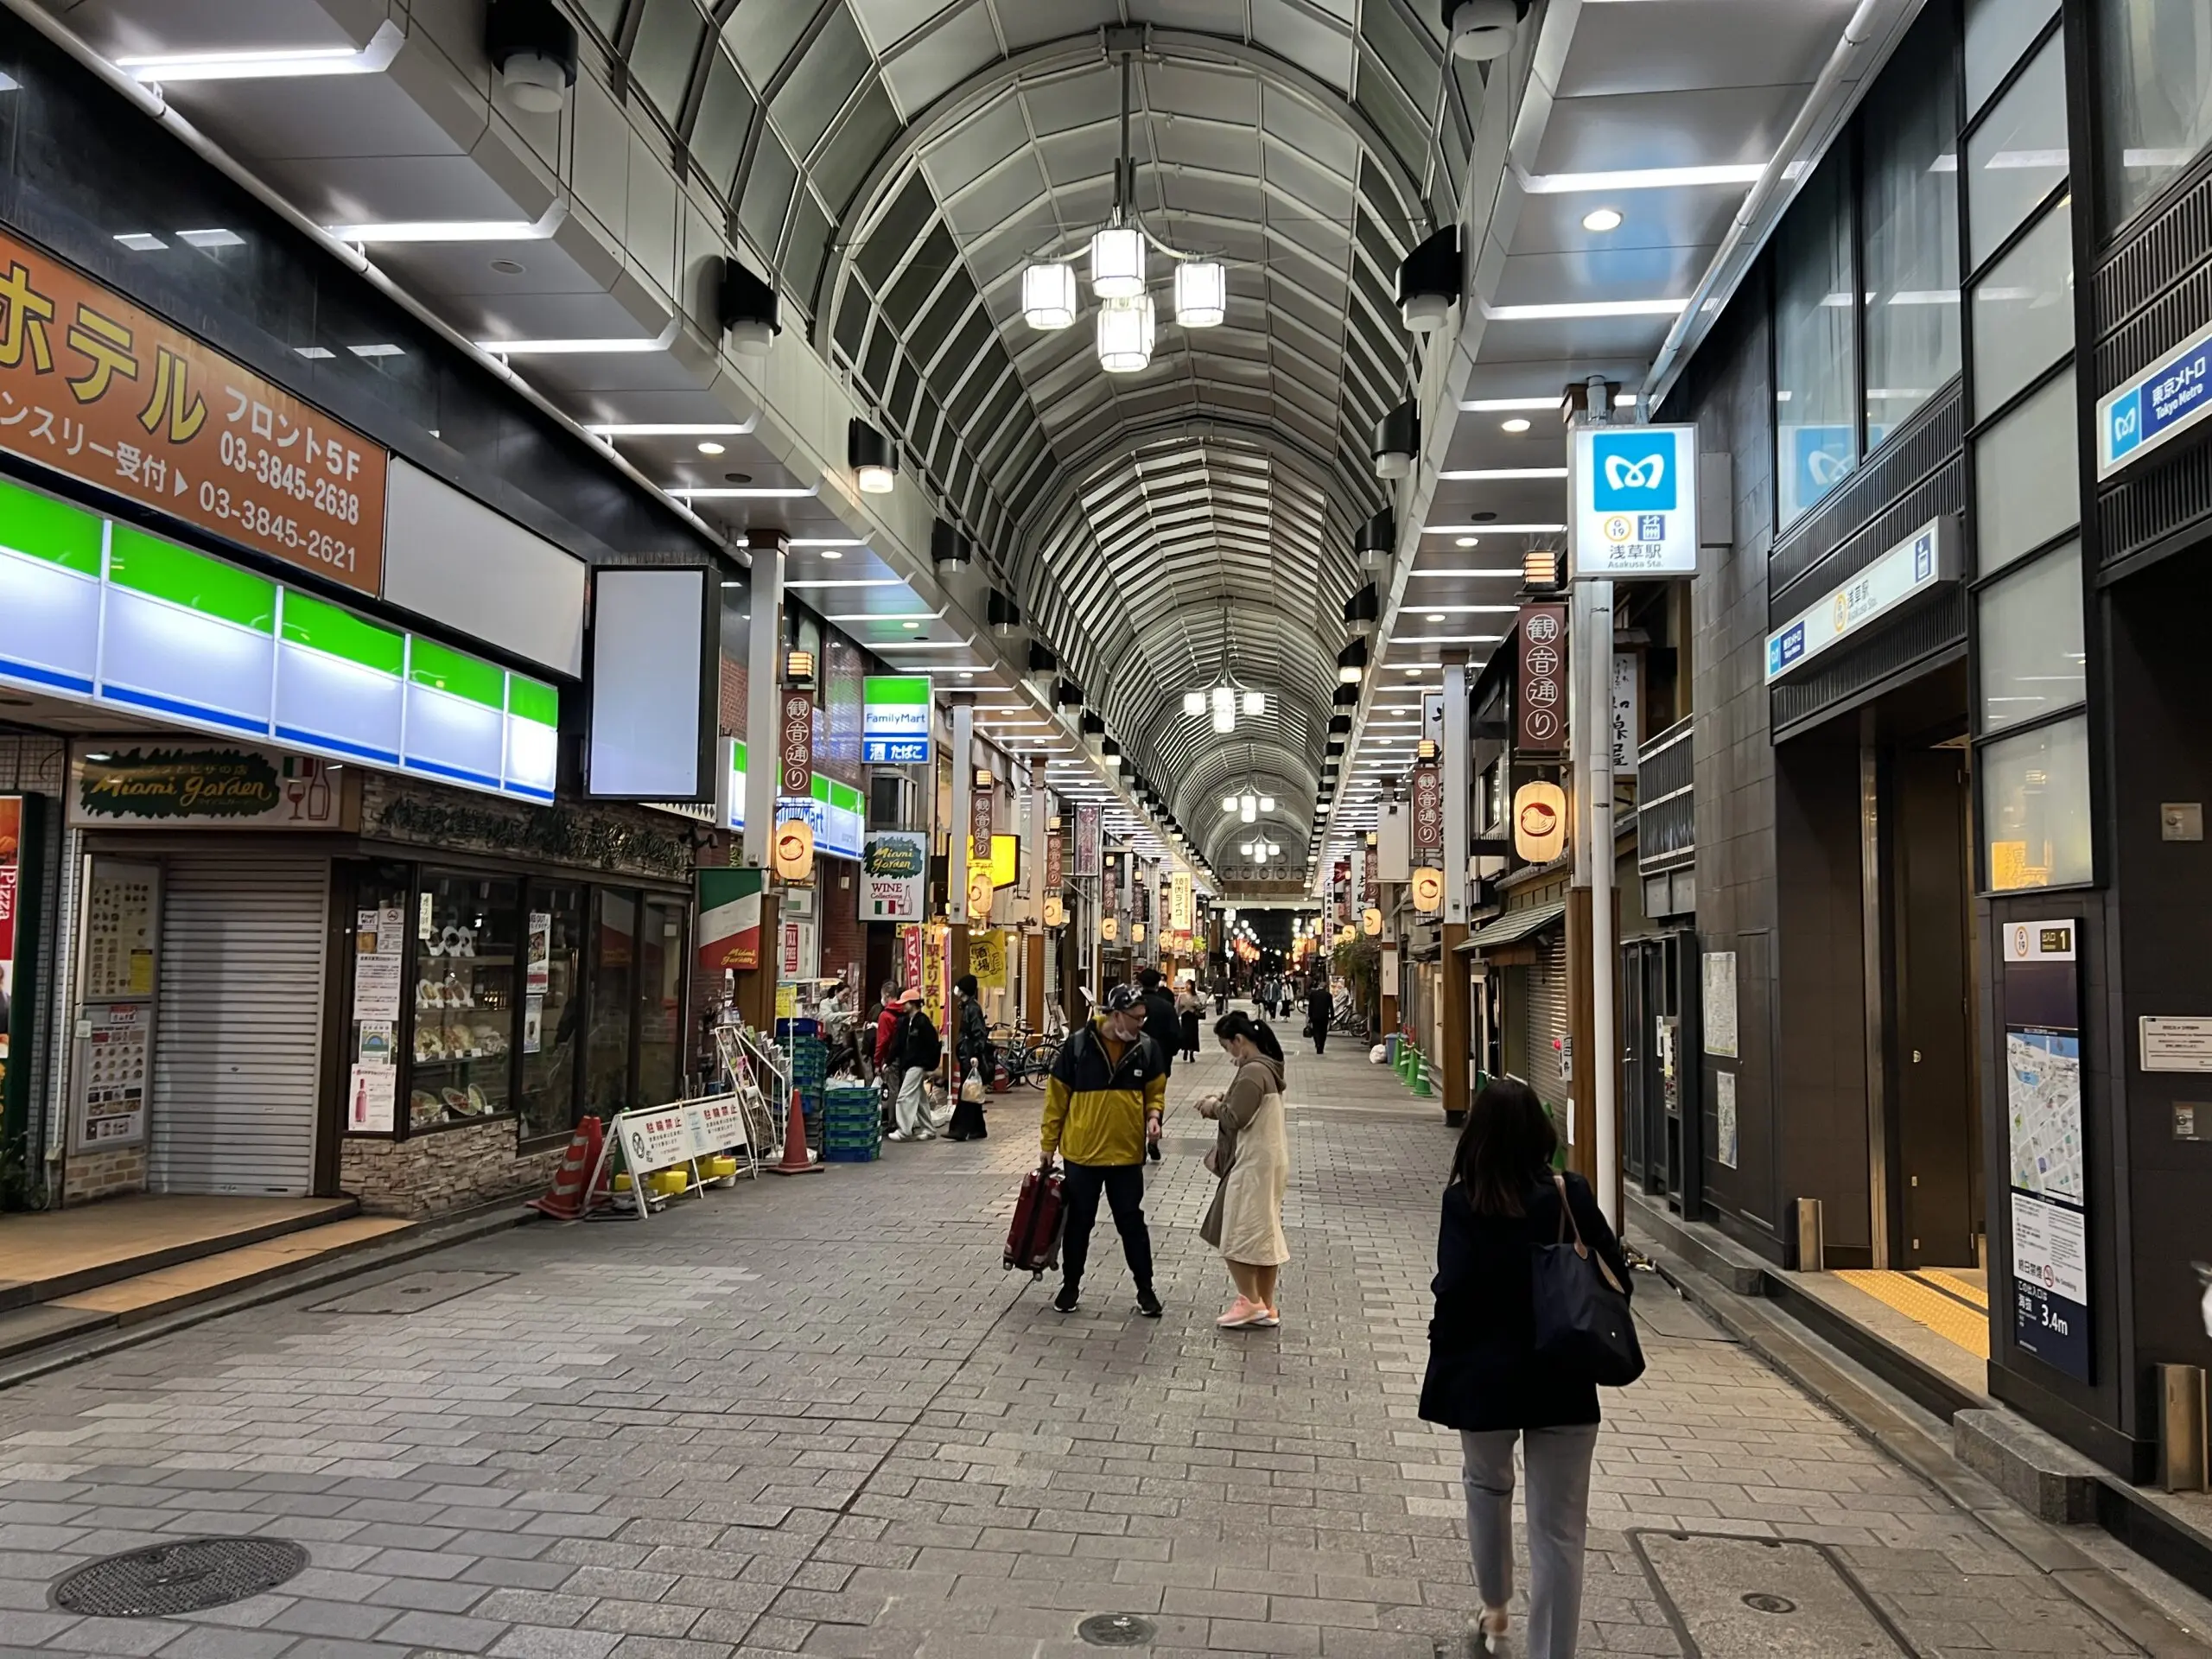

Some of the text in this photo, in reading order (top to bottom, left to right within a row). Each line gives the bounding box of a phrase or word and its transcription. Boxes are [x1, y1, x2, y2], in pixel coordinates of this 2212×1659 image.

[0, 260, 207, 444] ホテル
[2152, 356, 2206, 407] 東京メトロ
[2156, 383, 2203, 420] Tokyo Metro
[220, 430, 359, 525] 03-3845-2638
[200, 480, 355, 572] 03-3845-2621
[1608, 560, 1665, 569] Asakusa Sta.
[1610, 543, 1662, 560] 浅草駅
[1527, 614, 1558, 740] 観音通り
[866, 713, 926, 725] FamilyMart
[786, 698, 809, 789] 観音通り
[869, 743, 923, 760] 酒 たばこ
[90, 776, 177, 798] Miami
[1418, 773, 1437, 843] 観音通り
[975, 798, 990, 856] 観音通り
[873, 847, 914, 858] Miami
[0, 870, 16, 921] Pizza
[871, 883, 903, 893] WINE
[2060, 930, 2066, 950] 1
[645, 1116, 683, 1135] 駐輪禁止
[704, 1103, 738, 1121] 駐輪禁止
[2042, 1304, 2069, 1337] 3.4m
